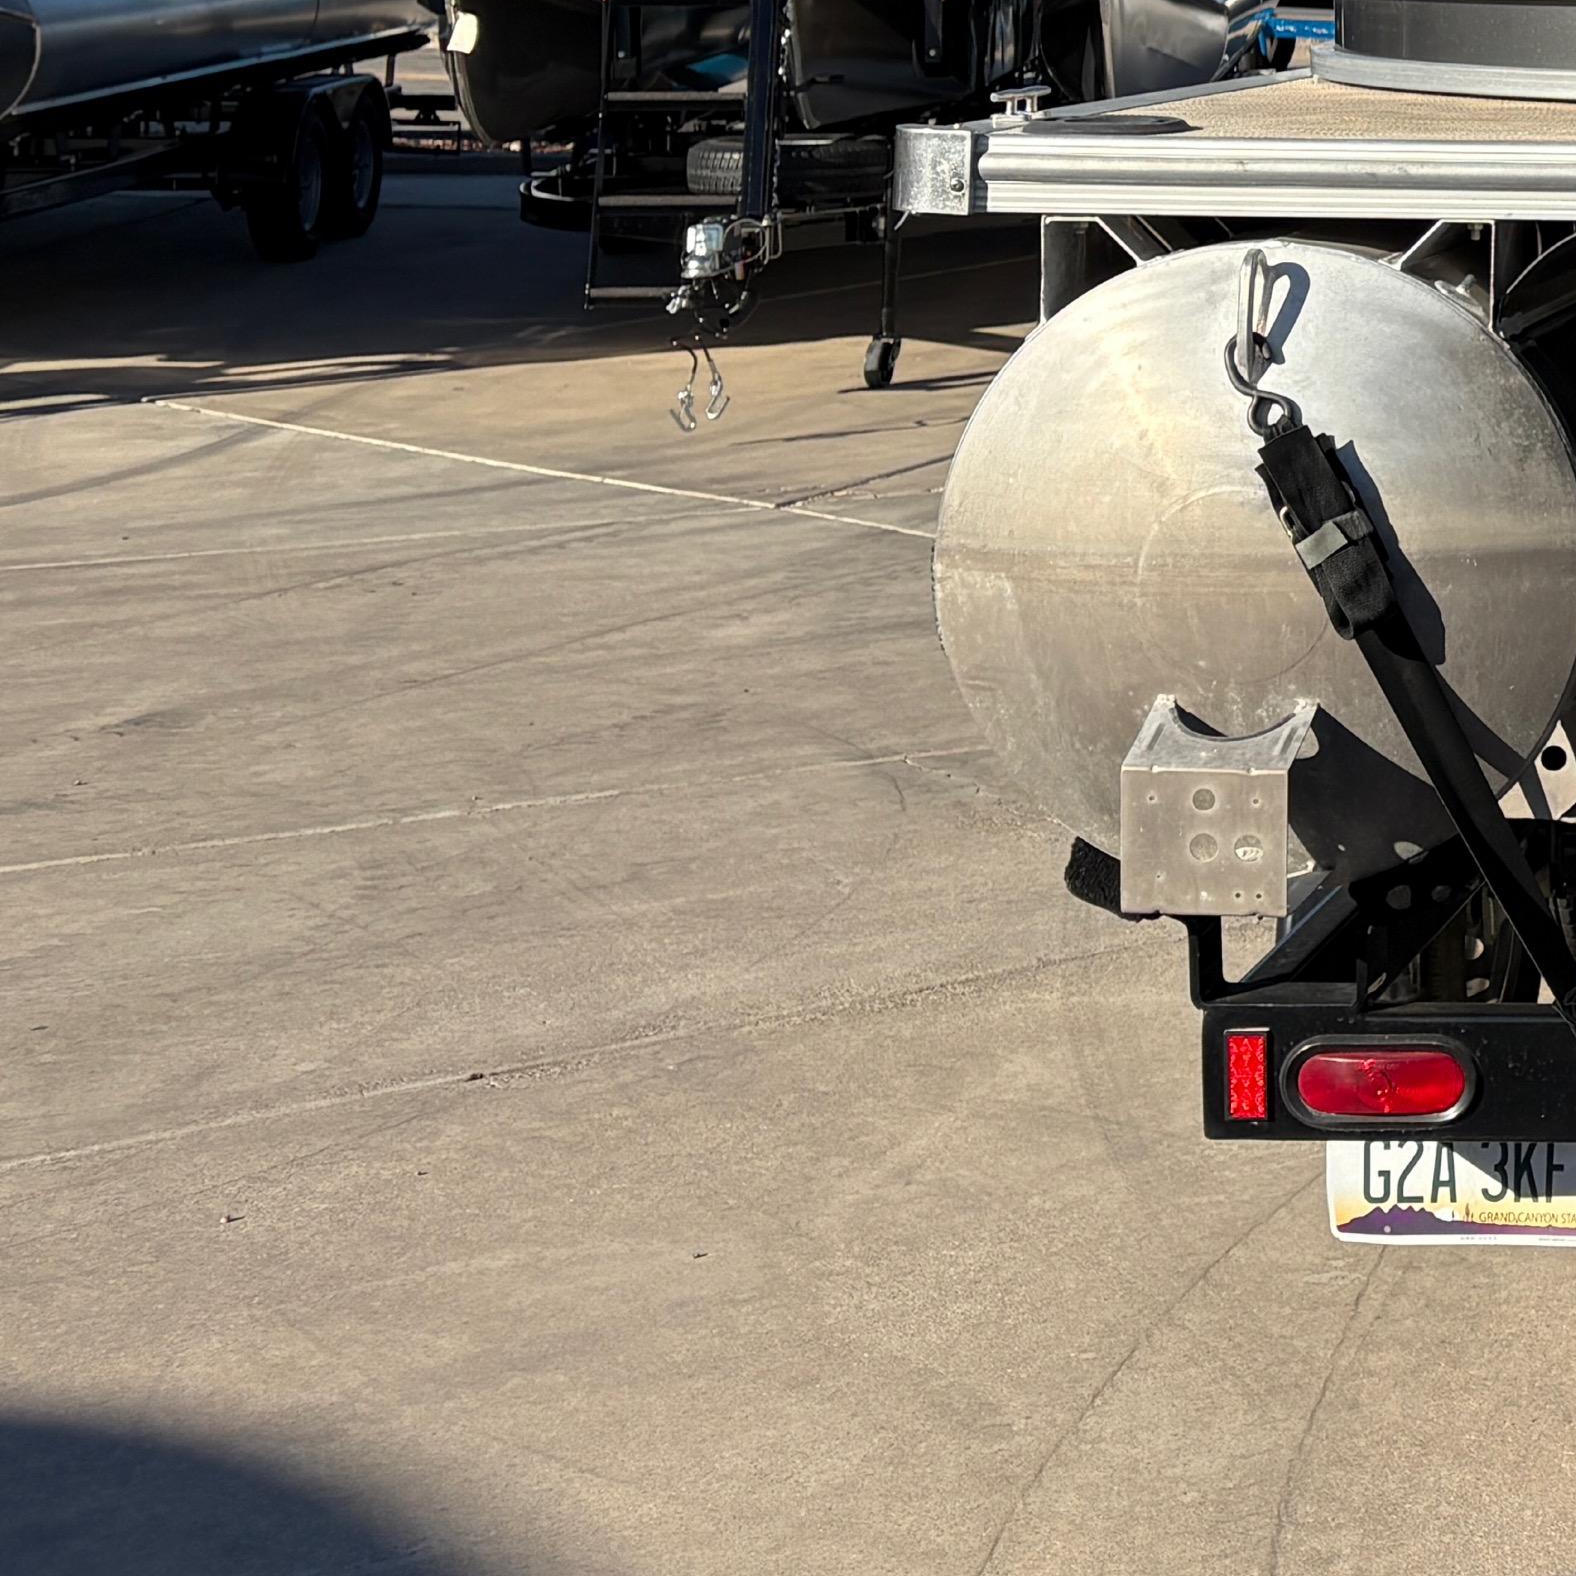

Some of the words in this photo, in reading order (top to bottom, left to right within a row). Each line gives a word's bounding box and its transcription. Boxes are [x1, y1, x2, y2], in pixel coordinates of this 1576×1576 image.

[1363, 1140, 1457, 1204] G2A
[1478, 1211, 1516, 1223] GRAND
[1517, 1212, 1559, 1224] CANYON
